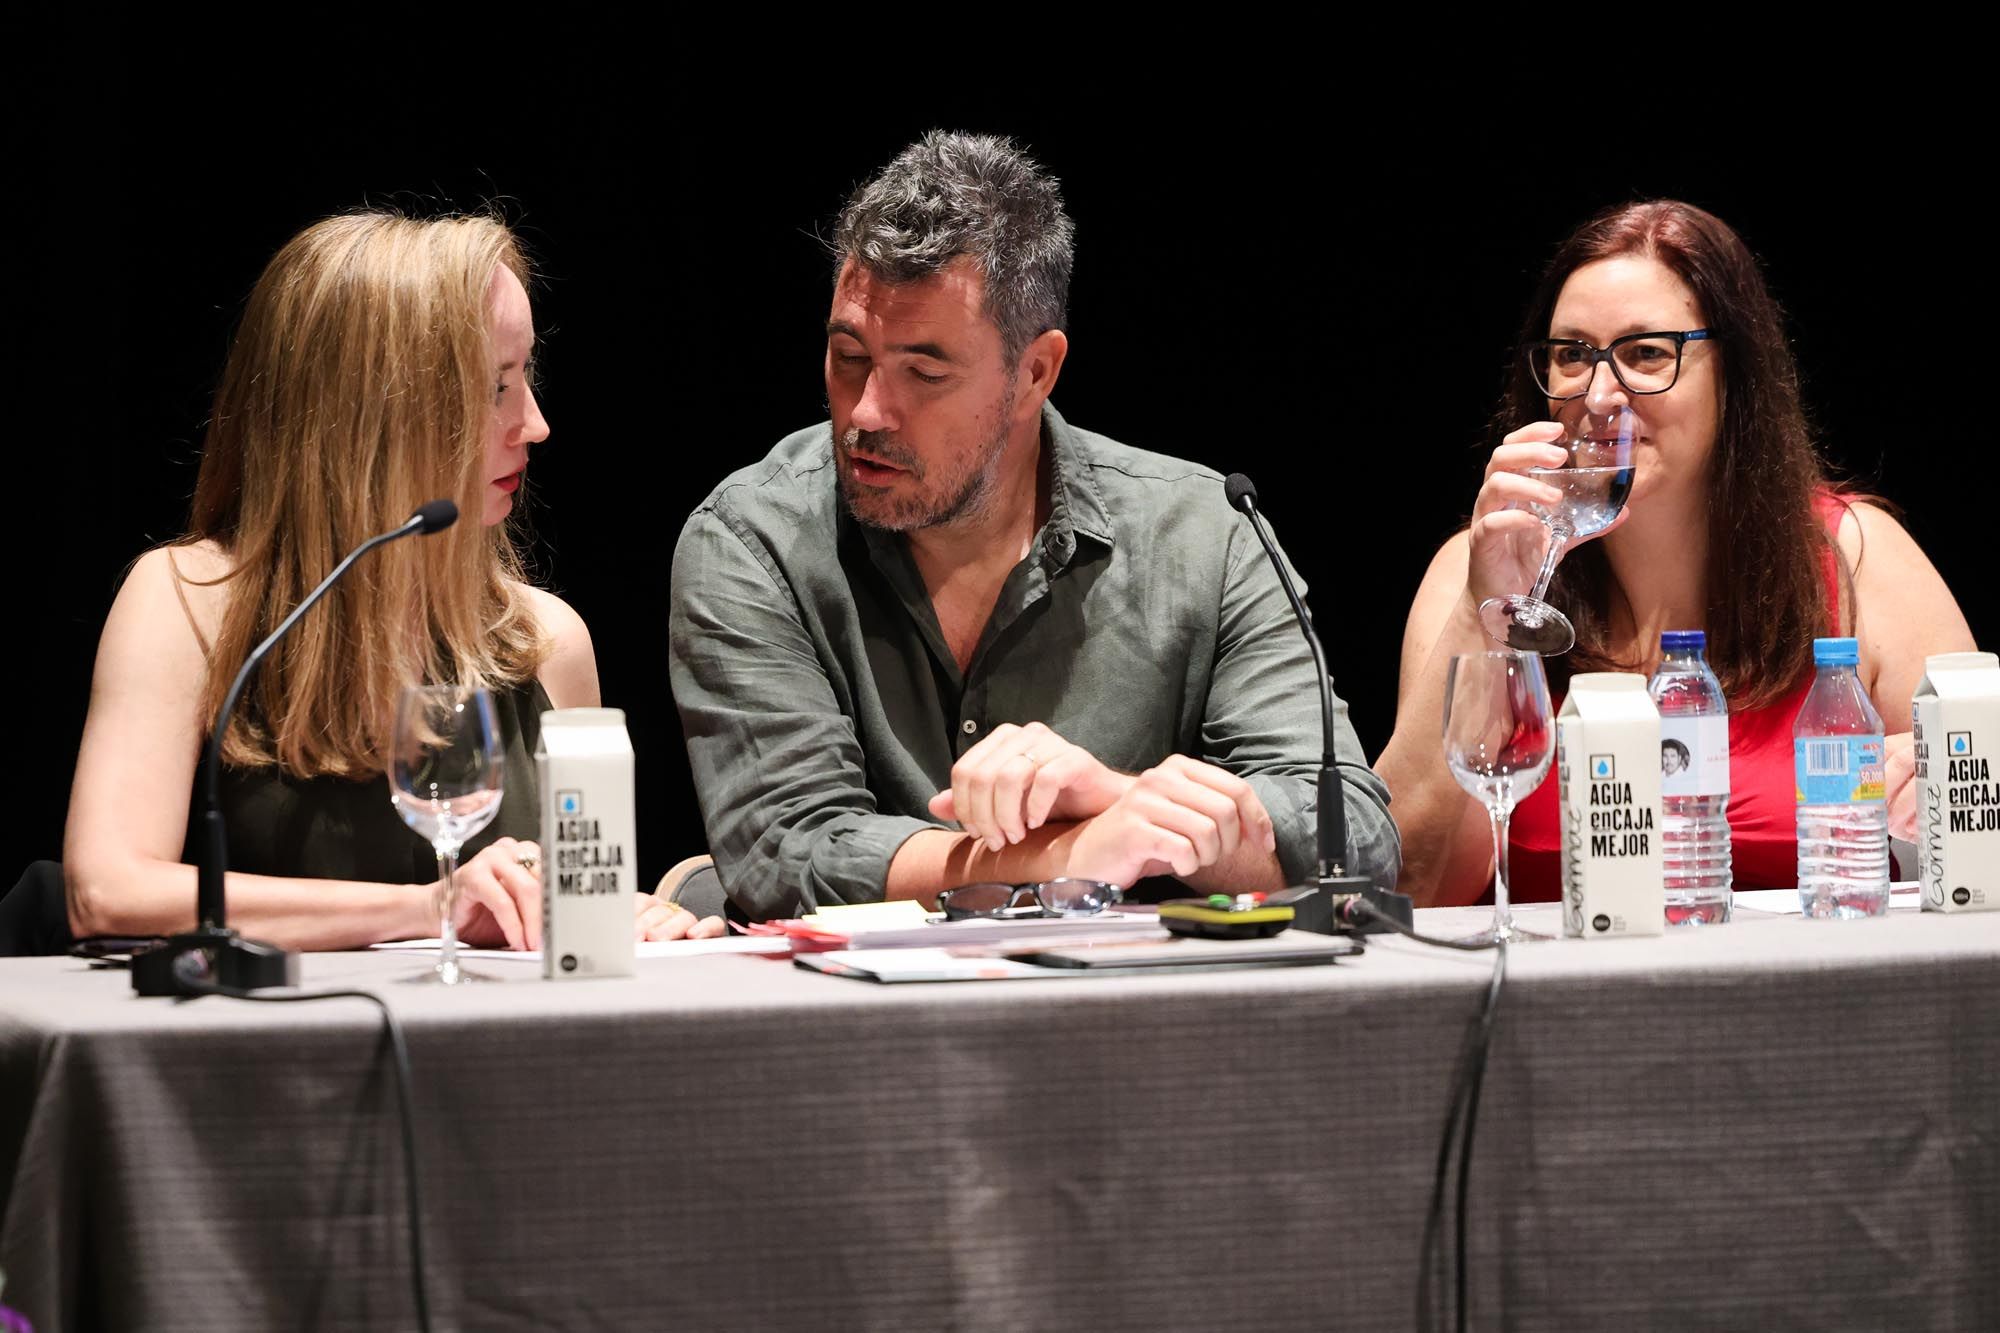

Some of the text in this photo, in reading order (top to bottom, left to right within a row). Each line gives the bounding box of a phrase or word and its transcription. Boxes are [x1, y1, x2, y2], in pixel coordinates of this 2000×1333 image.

[1948, 759, 1990, 782] AGUA
[1590, 782, 1632, 806] AGUA
[1591, 808, 1653, 830] enCAJA
[557, 820, 600, 842] AGUA
[1592, 834, 1648, 857] MEJOR
[558, 846, 622, 869] enCAJA
[559, 872, 619, 895] MEJOR
